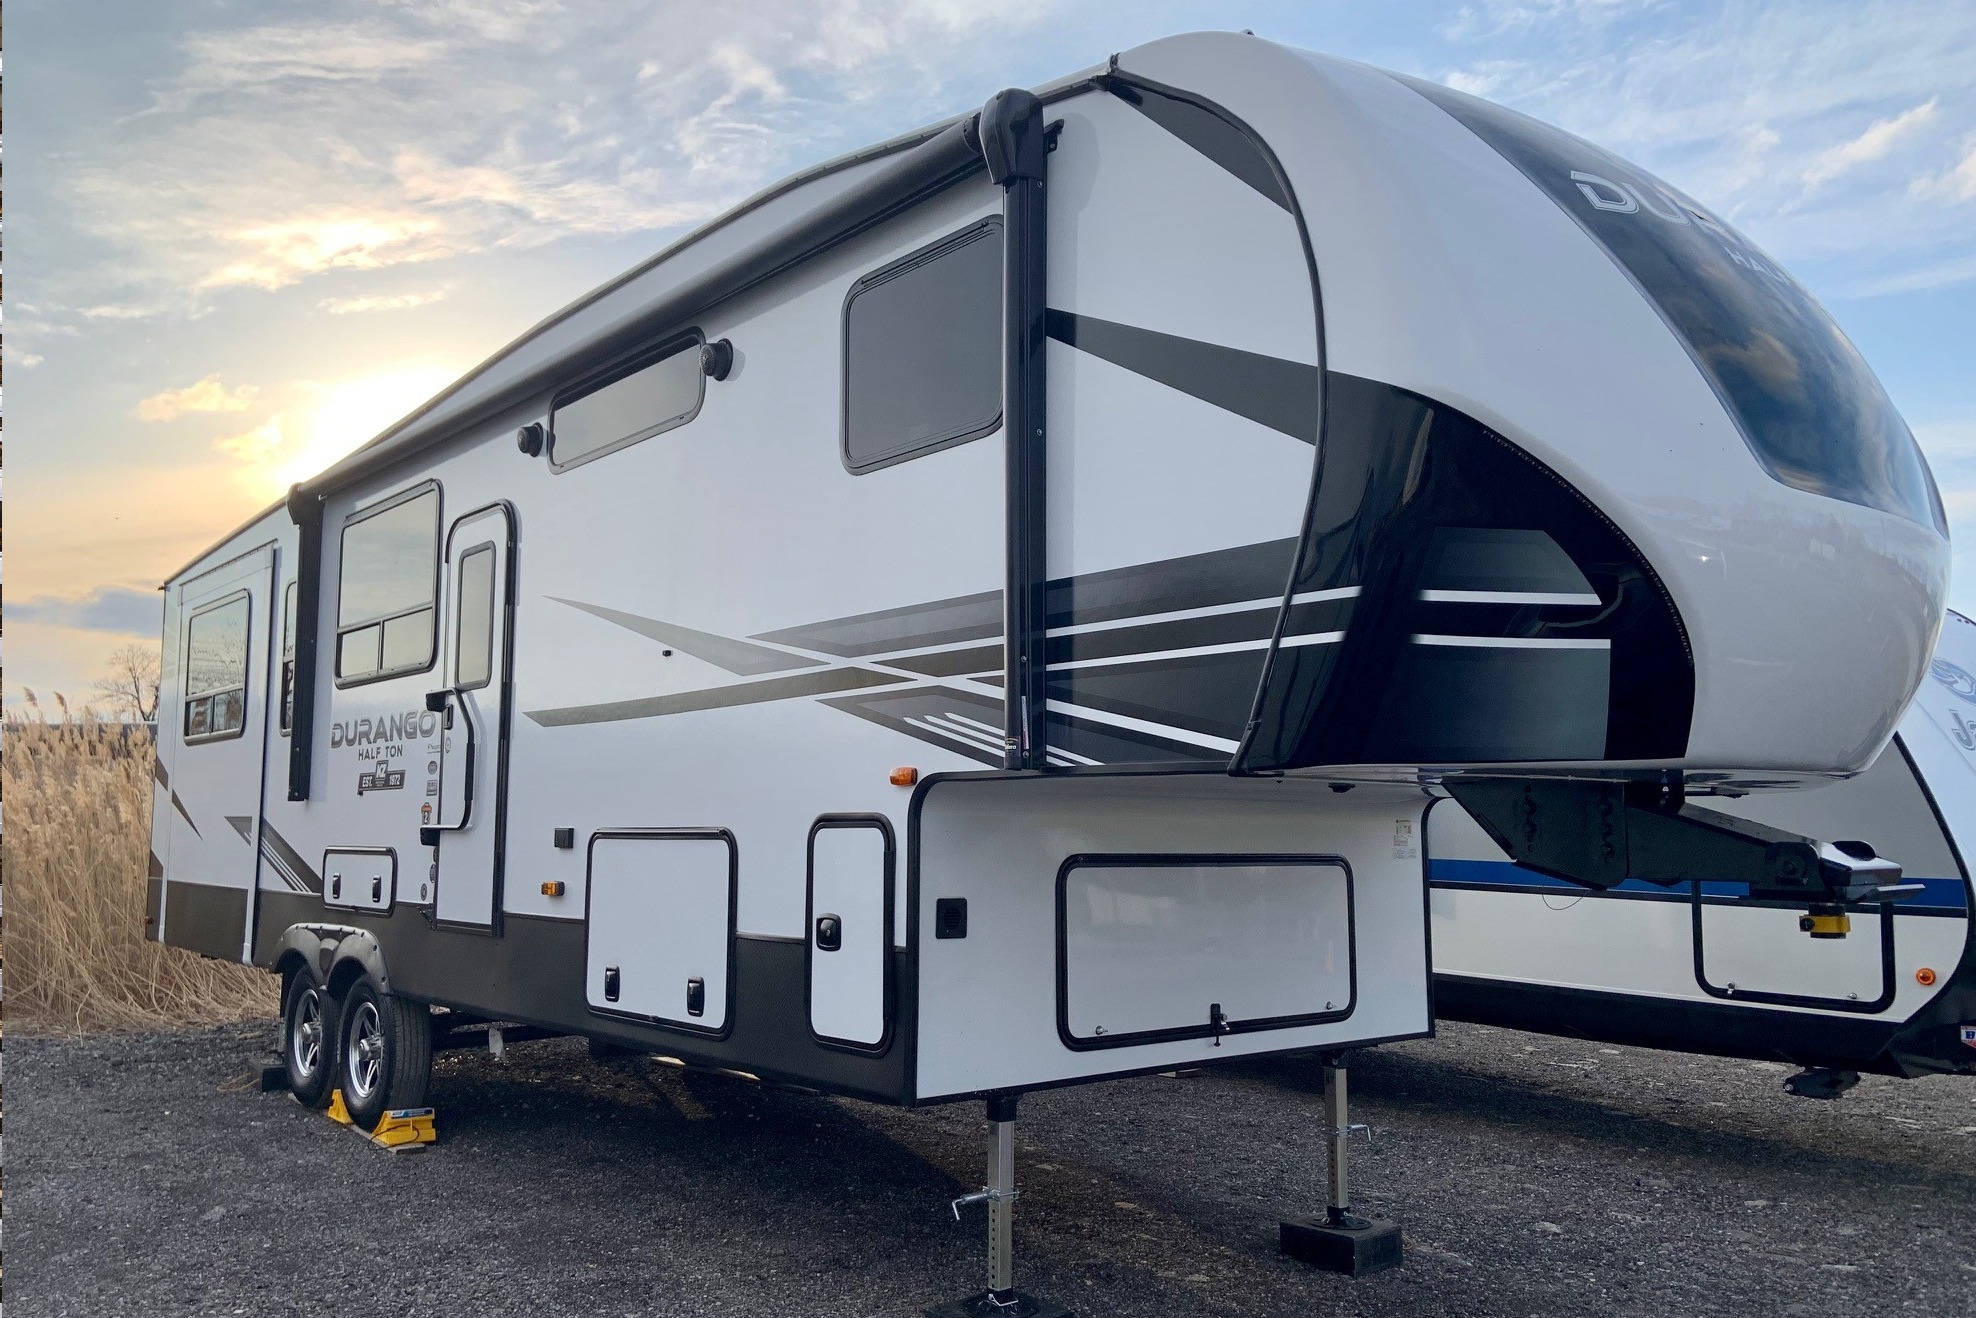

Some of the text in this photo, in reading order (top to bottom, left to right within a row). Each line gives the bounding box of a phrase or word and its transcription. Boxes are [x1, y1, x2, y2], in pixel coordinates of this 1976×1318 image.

[331, 709, 436, 748] DURANGO
[358, 744, 403, 761] HALF TON
[389, 774, 401, 786] 1972
